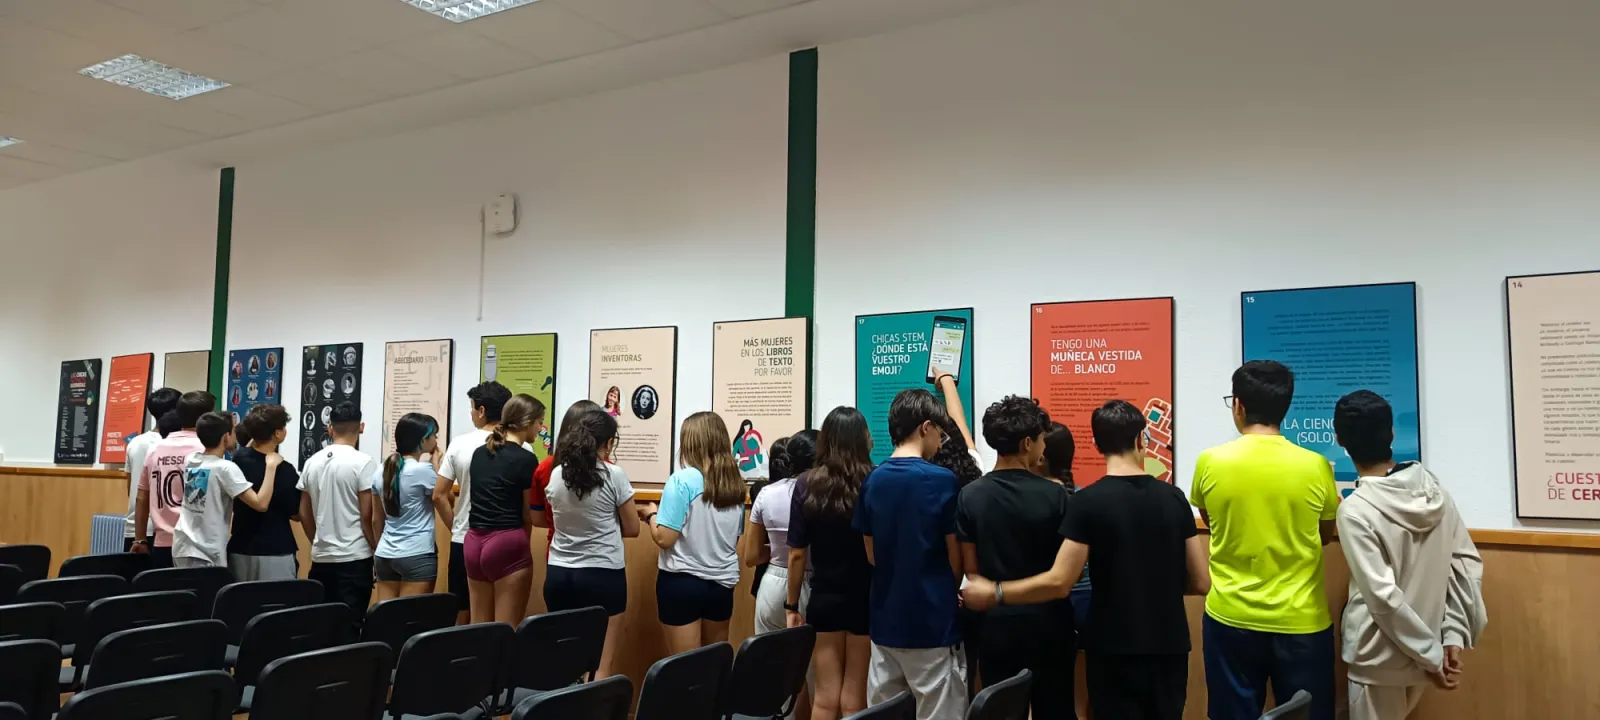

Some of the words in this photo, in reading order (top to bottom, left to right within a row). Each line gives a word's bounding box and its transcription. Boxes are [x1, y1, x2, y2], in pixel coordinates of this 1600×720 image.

[743, 337, 759, 347] MÁS
[760, 336, 793, 347] MUJERES
[872, 333, 900, 344] CHICAS
[1051, 339, 1083, 349] TENGO
[1086, 338, 1107, 348] UNA
[740, 349, 750, 357] EN
[752, 348, 765, 357] LOS
[766, 347, 793, 356] LIBROS
[872, 343, 905, 356] ¿DÓNDE
[907, 340, 929, 352] ESTÁ
[601, 353, 642, 362] INVENTORAS
[872, 354, 911, 364] VUESTRO
[1051, 350, 1095, 362] MUÑECA
[1098, 350, 1143, 361] VESTIDA
[757, 358, 767, 366] DE
[754, 368, 768, 376] POR
[770, 367, 793, 376] FAVOR
[872, 365, 903, 376] EMOJI?
[1074, 363, 1116, 374] BLANCO
[1283, 418, 1299, 430] LA
[1296, 431, 1335, 446] (SOLO)
[157, 455, 185, 466] MESSI
[152, 470, 184, 509] 10
[1548, 488, 1566, 500] DE
